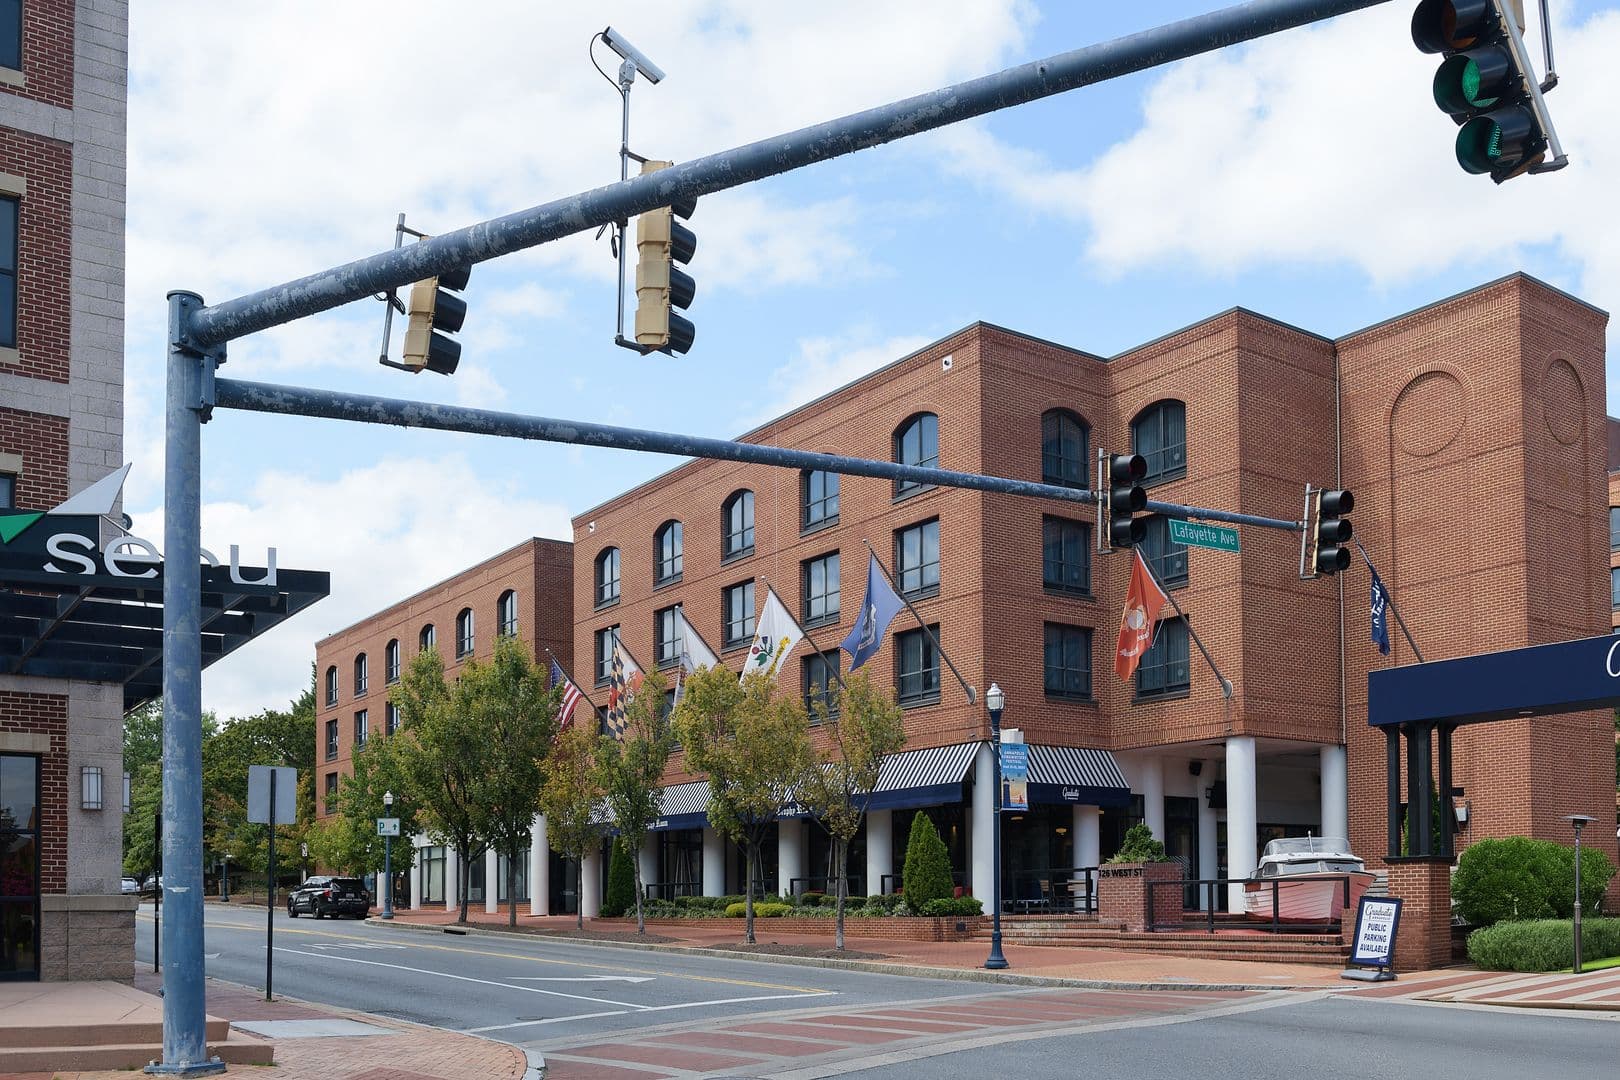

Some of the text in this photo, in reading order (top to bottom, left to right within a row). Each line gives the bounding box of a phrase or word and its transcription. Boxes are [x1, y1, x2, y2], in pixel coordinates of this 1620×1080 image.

[1173, 523, 1235, 546] Lafayette Ave
[42, 532, 278, 587] seu
[379, 822, 384, 833] P
[1099, 868, 1142, 878] 126 WEST ST
[1365, 904, 1392, 919] Graduate
[1367, 923, 1387, 932] PUBLIC
[1363, 933, 1387, 942] PARKING
[1359, 943, 1388, 953] AVAILABLE
